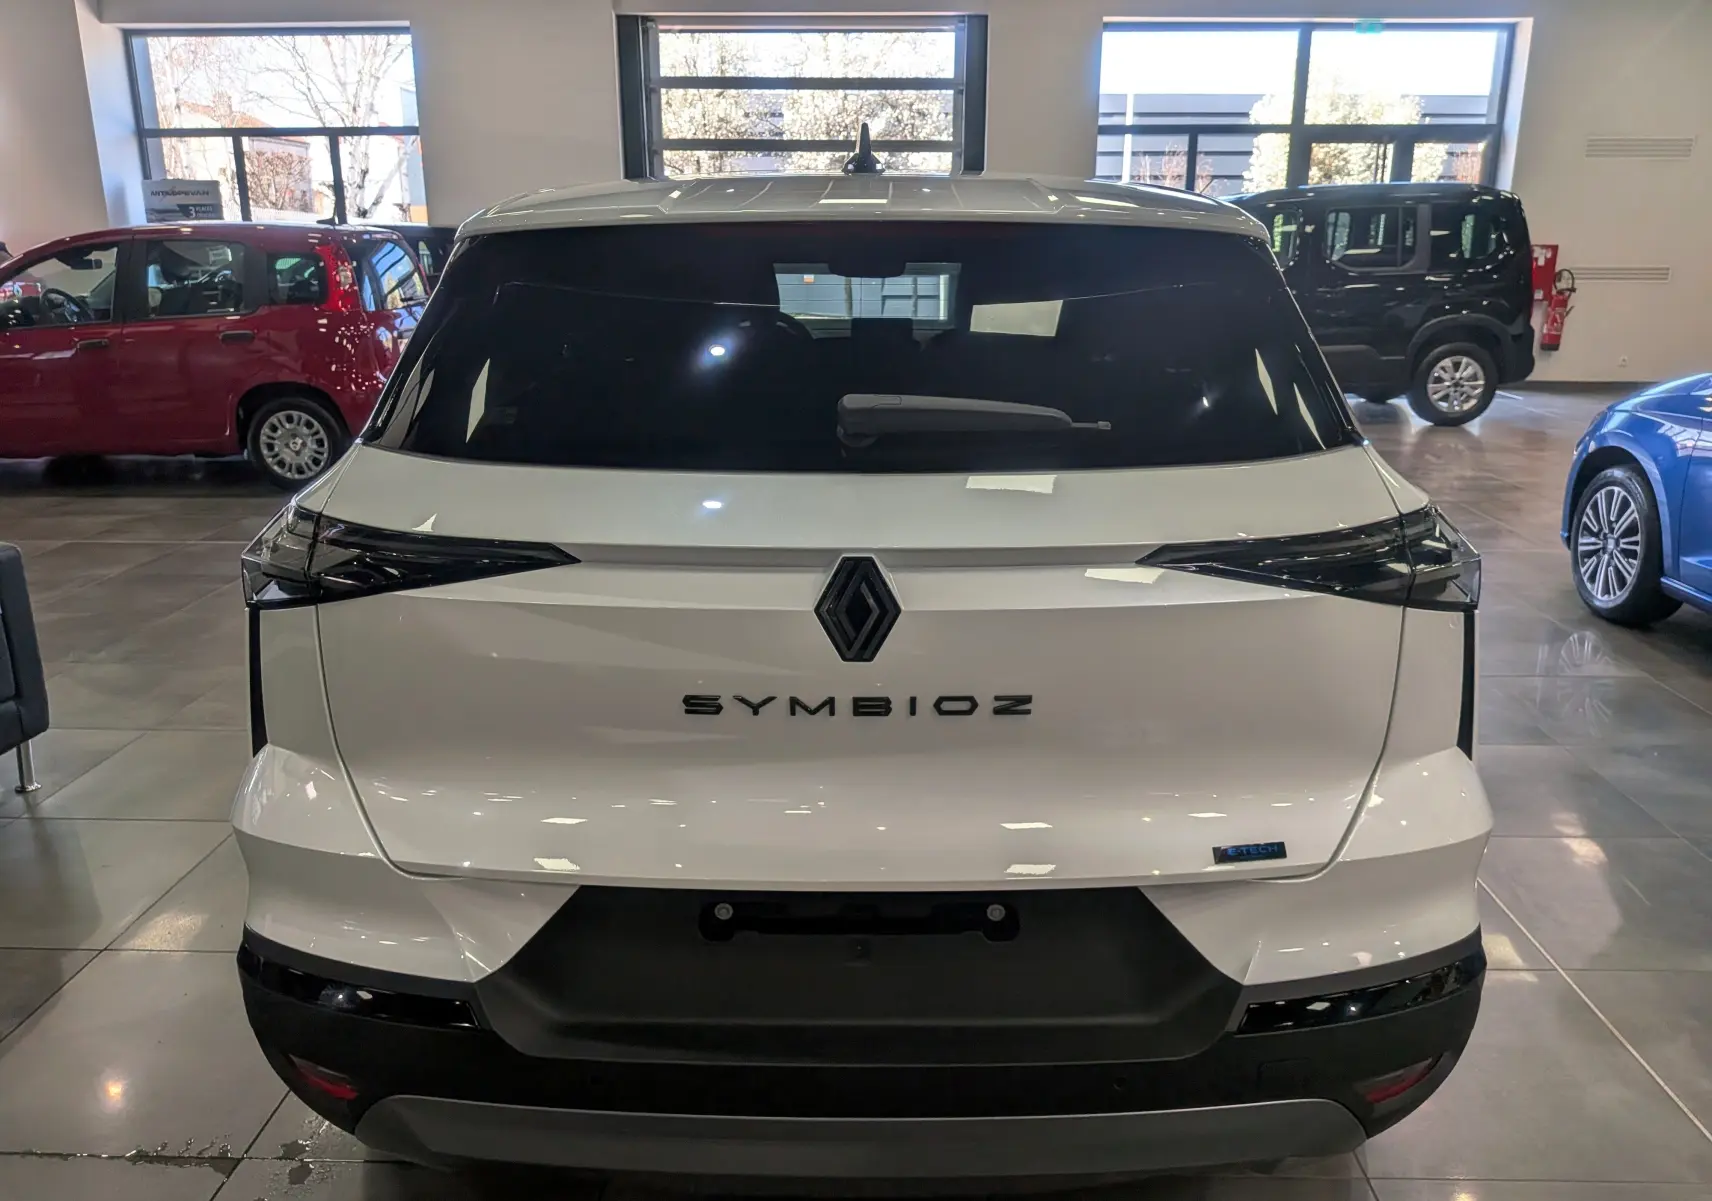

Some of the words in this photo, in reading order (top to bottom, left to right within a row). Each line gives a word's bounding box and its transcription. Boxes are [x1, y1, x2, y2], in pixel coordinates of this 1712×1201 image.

[189, 206, 196, 218] 3
[682, 694, 1033, 717] SYMBIOZ
[1227, 844, 1278, 856] E-TECH
